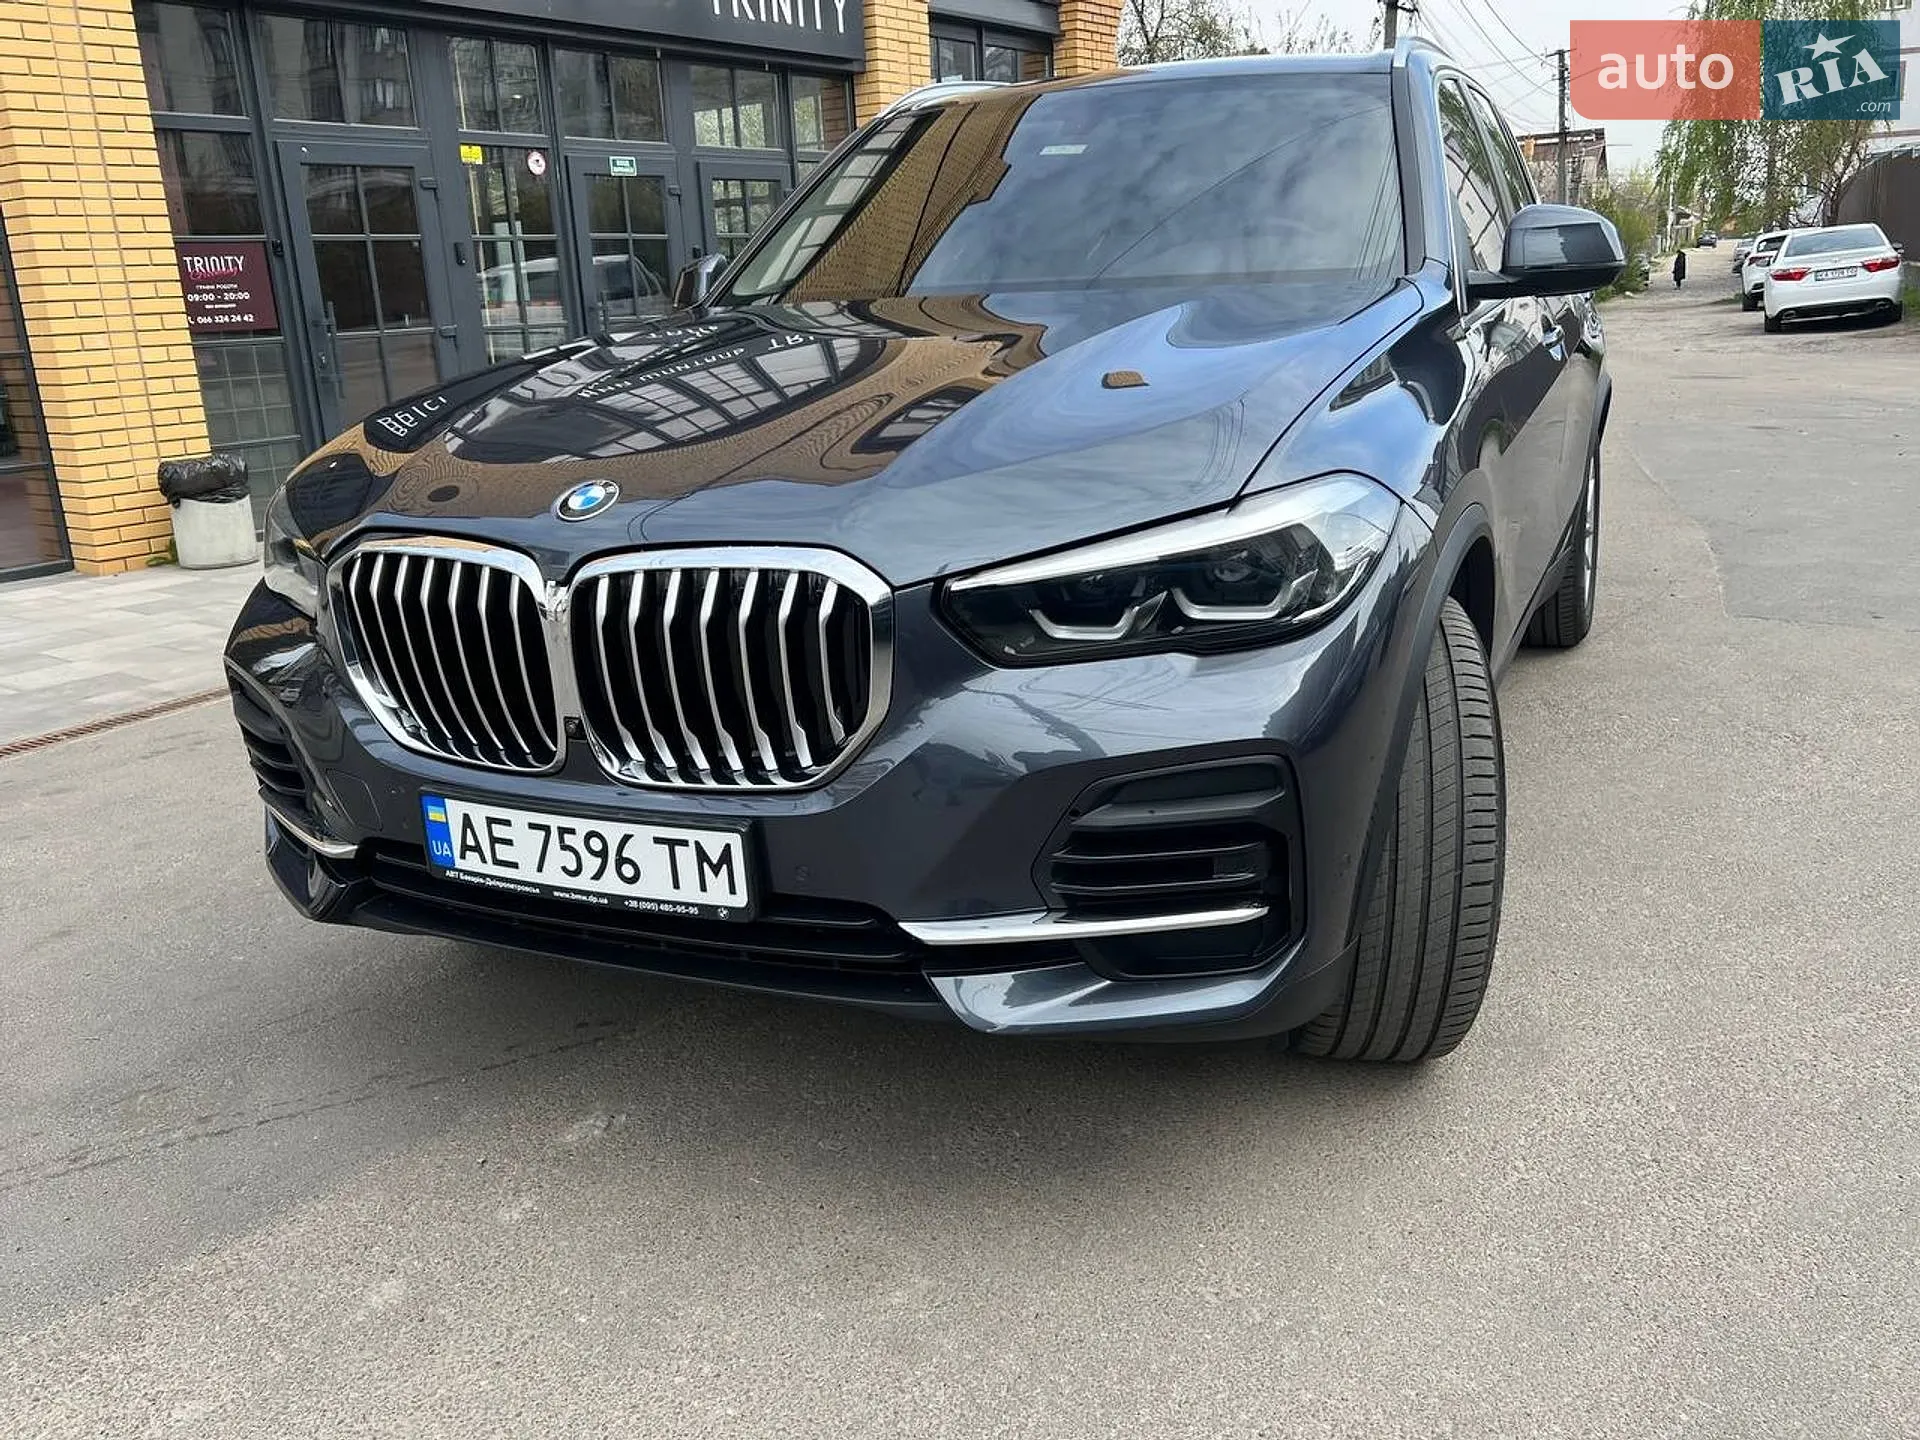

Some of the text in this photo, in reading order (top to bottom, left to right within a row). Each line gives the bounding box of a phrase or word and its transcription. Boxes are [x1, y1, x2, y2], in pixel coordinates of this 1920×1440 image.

[183, 256, 244, 273] TRINITY
[187, 293, 215, 301] 09:00
[223, 292, 250, 300] 20:00
[231, 314, 241, 323] 24
[243, 314, 254, 322] 42
[432, 839, 452, 858] UA
[459, 813, 738, 896] AE 7596 TM
